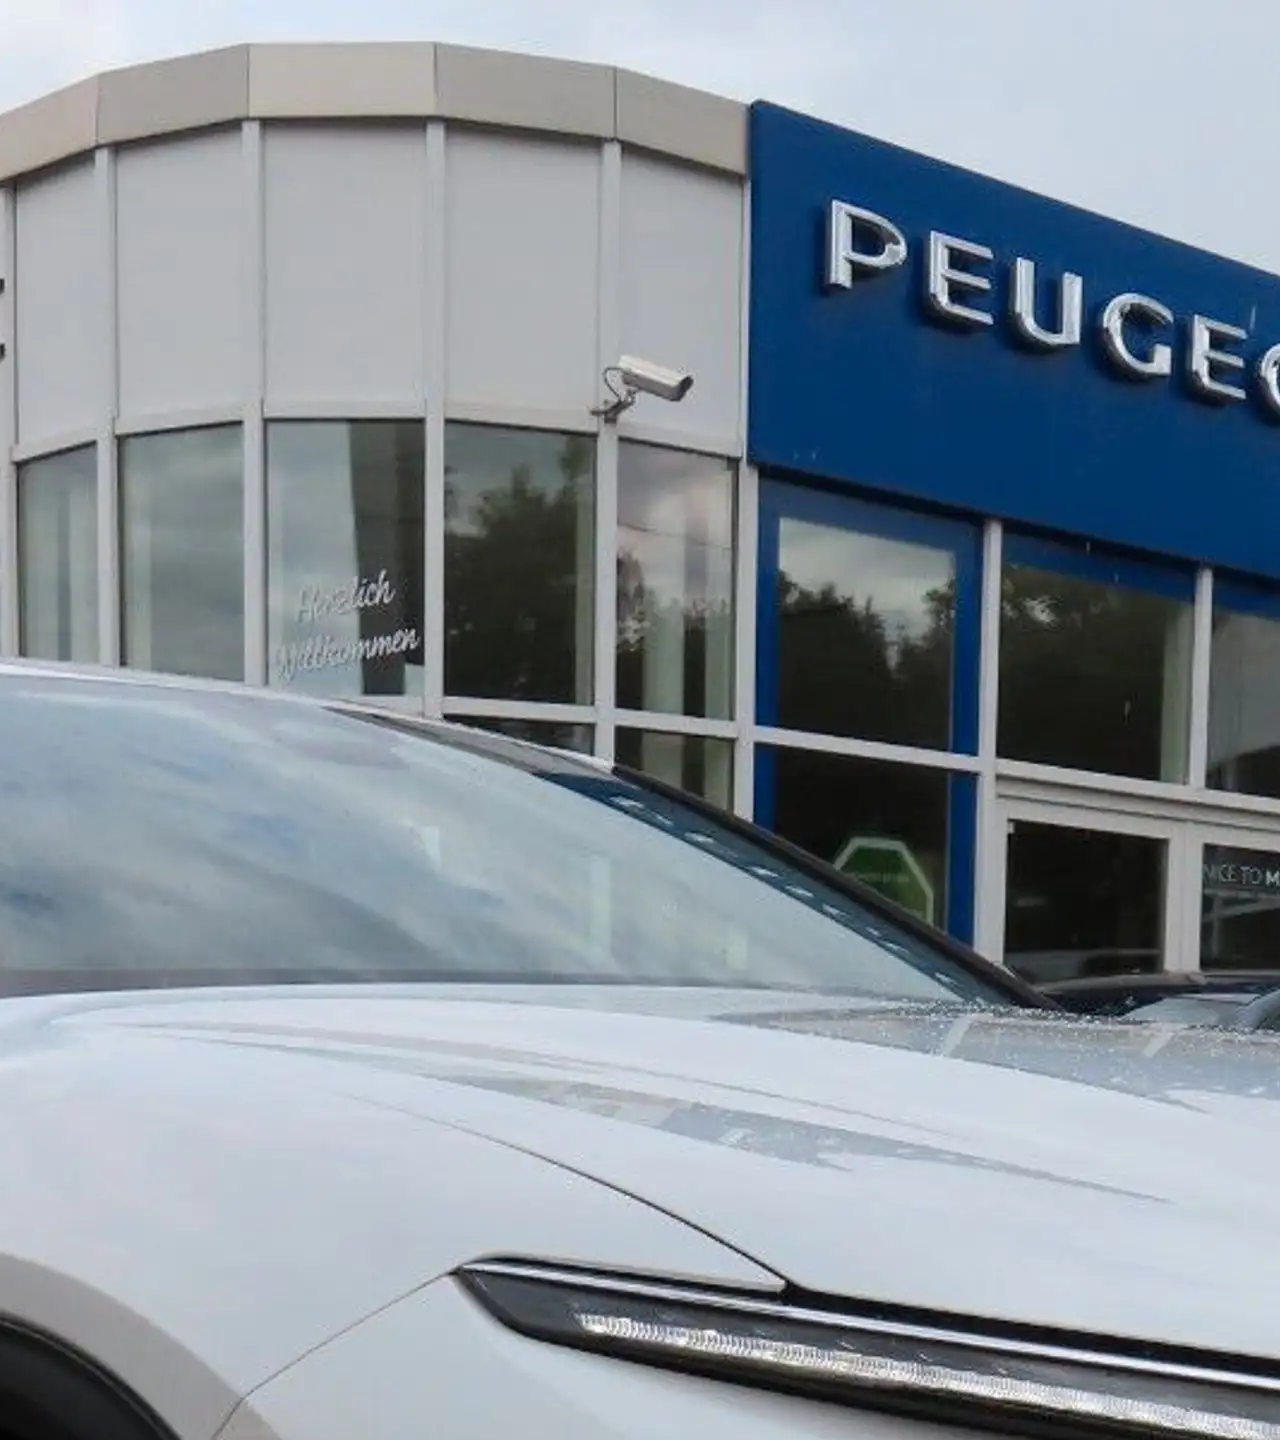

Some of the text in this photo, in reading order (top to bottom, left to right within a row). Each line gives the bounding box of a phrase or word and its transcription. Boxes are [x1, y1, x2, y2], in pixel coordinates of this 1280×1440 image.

[297, 568, 397, 624] Herzlich
[276, 627, 421, 683] Willkommen
[1239, 865, 1263, 885] TO
